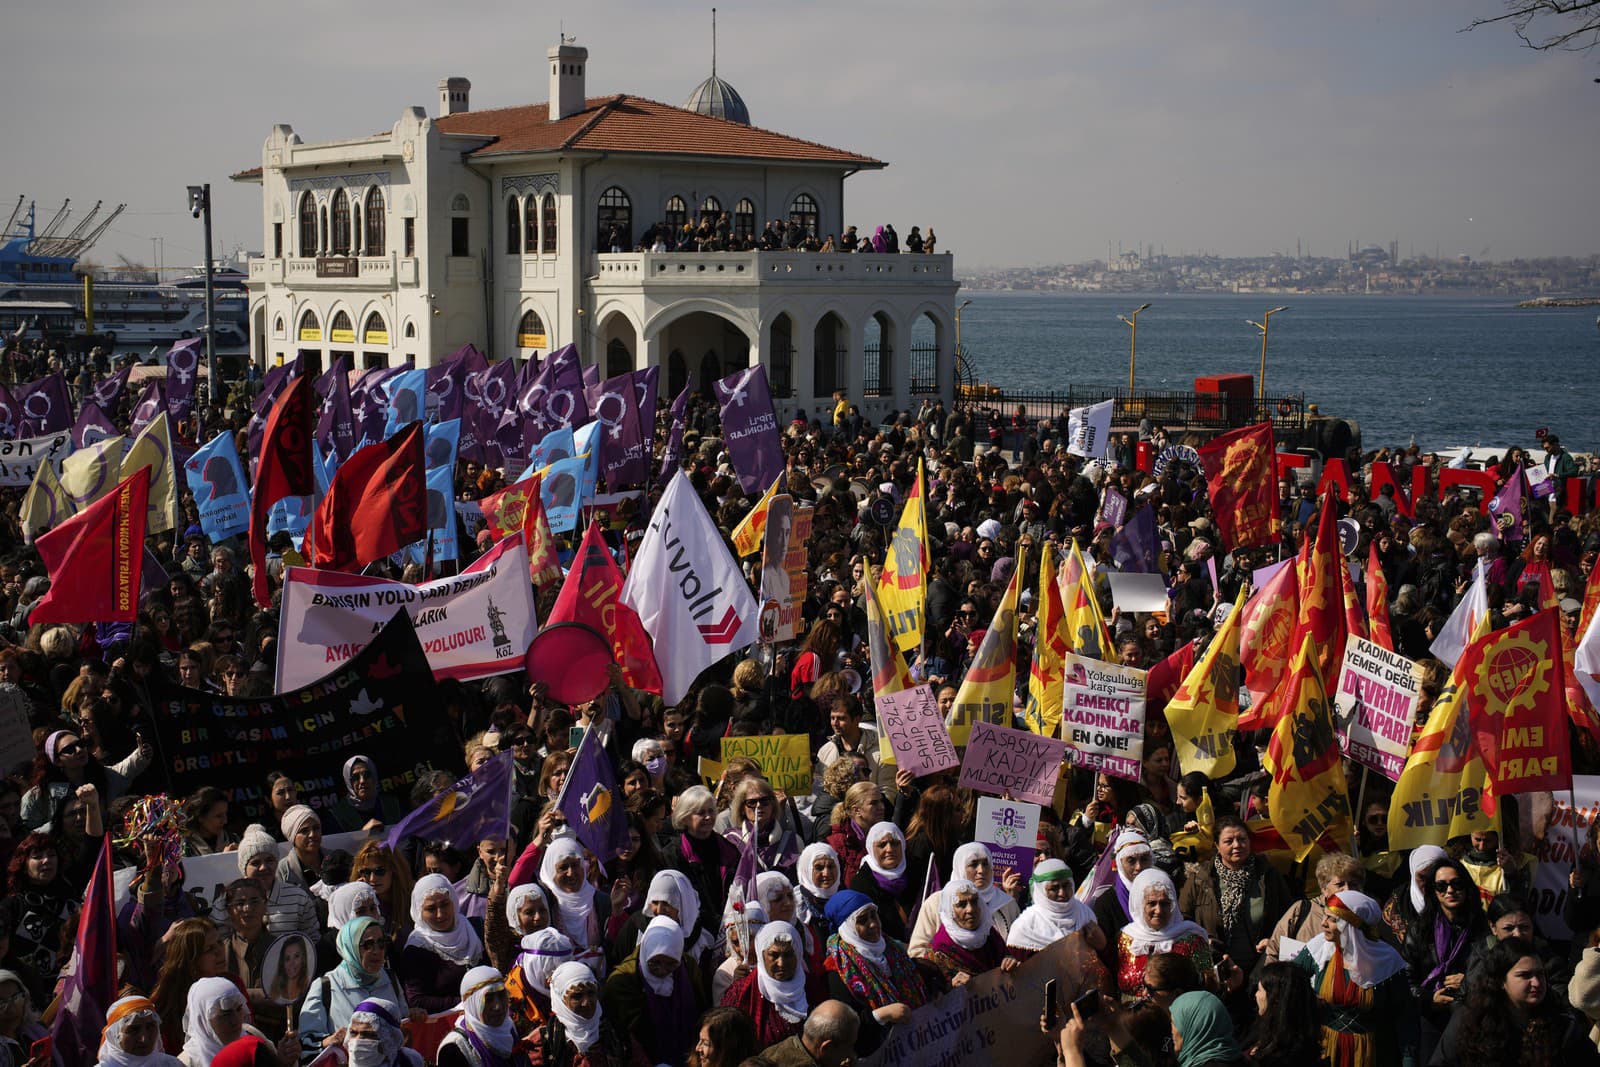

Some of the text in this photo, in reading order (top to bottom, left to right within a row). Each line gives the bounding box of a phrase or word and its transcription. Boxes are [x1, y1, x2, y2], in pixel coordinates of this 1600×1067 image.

[312, 593, 370, 611] BARIŞIN
[375, 589, 415, 605] YOLU
[1357, 640, 1412, 674] KADINLAR
[1087, 670, 1144, 688] Yoksulluğa
[1347, 650, 1417, 692] YEMEK DEĞİL
[1091, 681, 1116, 695] karşı
[1343, 668, 1411, 721] DEVRİM
[915, 688, 934, 717] ÖNLE
[1076, 693, 1130, 717] EMEKÇİ
[1064, 708, 1140, 733] KADINLAR
[1357, 703, 1411, 746] YAPAR!
[724, 738, 780, 758] KADIN
[1073, 729, 1128, 751] EN ÖNE!
[984, 749, 1057, 780] KADIN
[1085, 754, 1137, 777] EŞİTLİK
[1350, 743, 1402, 775] EŞİTLİK
[293, 776, 336, 793] ADIN
[1003, 807, 1015, 826] 8
[991, 858, 1018, 866] ADINLAR
[999, 982, 1017, 1003] Ye
[976, 1029, 996, 1049] Ye
